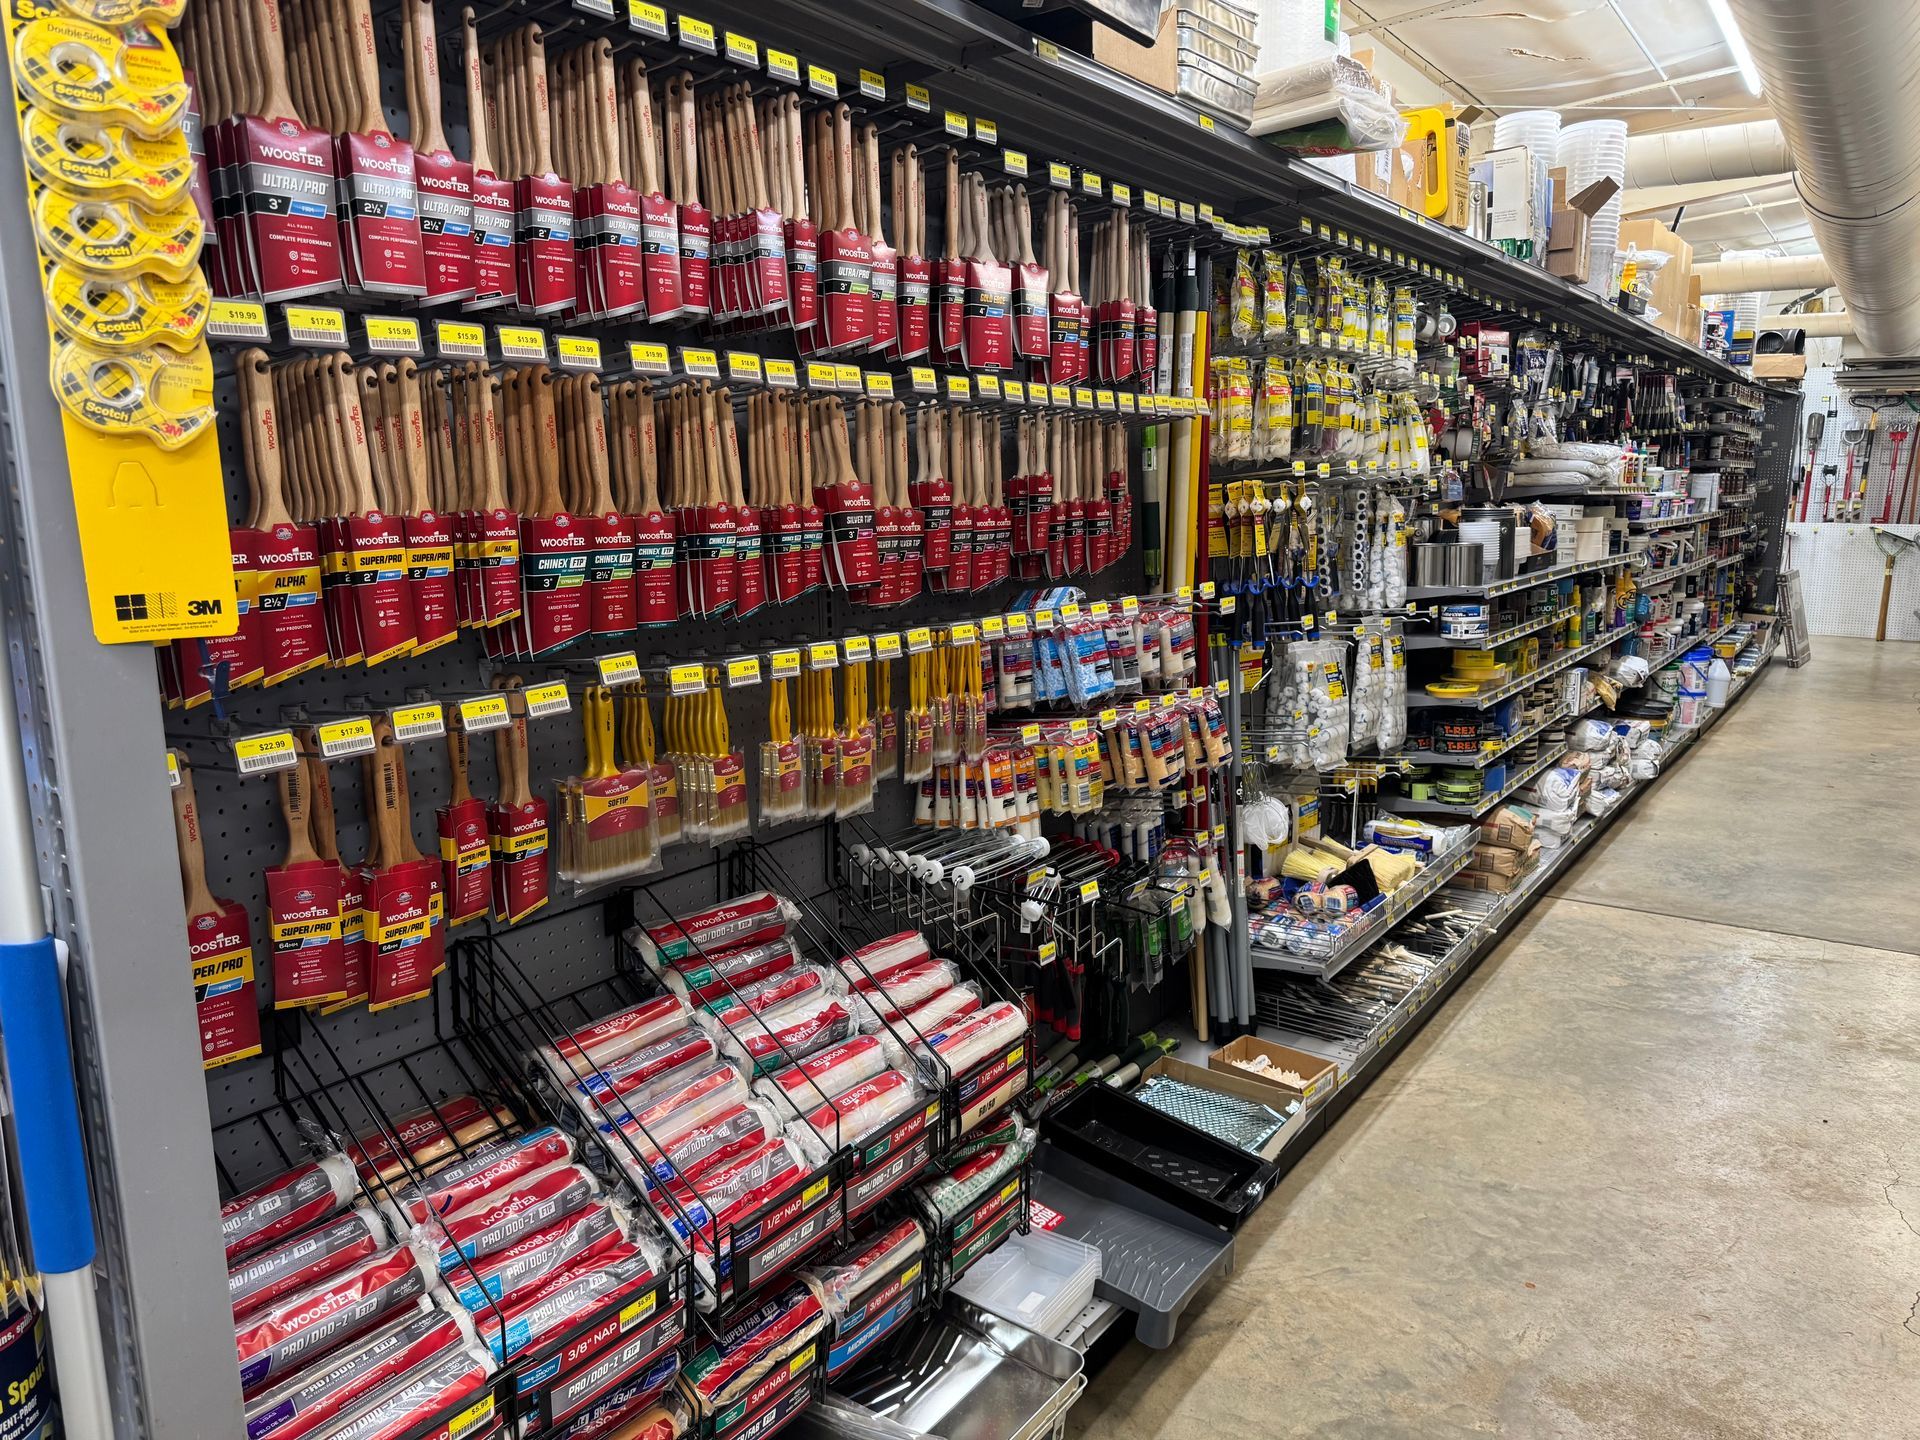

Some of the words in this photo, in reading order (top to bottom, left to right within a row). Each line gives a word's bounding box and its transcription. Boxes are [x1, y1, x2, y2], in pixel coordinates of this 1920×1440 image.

[644, 9, 661, 21] $13.99
[55, 83, 103, 103] Scotch
[259, 145, 324, 166] WOOSTER
[62, 162, 109, 178] Scotch
[358, 157, 412, 175] WOOSTER
[262, 173, 326, 195] ULTRA/PRO
[363, 181, 413, 200] ULTRA/PRO
[421, 176, 470, 193] WOOSTER
[473, 193, 510, 208] OOSTER
[535, 195, 571, 208] WOOSTER
[423, 200, 470, 217] ULTRA/PRO
[606, 202, 638, 214] WOOSTER
[537, 214, 571, 226] ULTRA/PRO
[645, 212, 675, 225] WOOSTER
[683, 223, 709, 234] WOOSTER
[163, 244, 185, 255] 3M
[795, 239, 817, 248] WOOSTER
[85, 246, 130, 257] Scotch
[838, 247, 869, 260] WOOSTER
[838, 266, 869, 279] ULTRA/PRO
[906, 272, 928, 281] WOOSTER
[229, 310, 257, 320] $19.99
[1057, 306, 1079, 315] WOOSTER
[96, 322, 141, 333] Scotch
[172, 315, 194, 328] 3M
[310, 316, 336, 328] $17.99
[388, 327, 411, 336] $15.99
[457, 332, 478, 341] $15.99
[517, 335, 538, 344] $13.99
[575, 345, 593, 353] $23.99
[646, 349, 663, 359] $19.99
[85, 401, 129, 422] Scotch
[162, 423, 184, 436] 3M
[261, 407, 276, 450] WOOSTER
[843, 495, 871, 507] WOOSTER
[709, 519, 736, 529] WOOSTER
[804, 519, 824, 527] WOOSTER
[846, 516, 862, 525] SILVER
[409, 531, 449, 544] WOOSTER
[486, 527, 517, 537] WOOSTER
[595, 531, 632, 544] WOOSTER
[639, 530, 673, 540] WOOSTER
[355, 532, 400, 547] WOOSTER
[540, 532, 585, 548] WOOSTER
[494, 544, 512, 553] ALPHA
[259, 547, 313, 565] WOOSTER
[359, 554, 402, 567] SUPER/PRO
[411, 551, 450, 563] SUPER/PRO
[594, 553, 618, 564] CHINEX
[538, 558, 569, 571] CHINEX
[274, 575, 307, 589] ALPHA
[187, 599, 222, 616] 3M
[615, 660, 632, 669] $14.99
[684, 670, 699, 679] $10.99
[542, 690, 561, 699] $14.99
[479, 704, 500, 713] $17.99
[412, 711, 435, 721] $17.99
[341, 726, 364, 737] $17.99
[1444, 726, 1476, 735] T-REX
[259, 740, 285, 751] $22.99
[1447, 741, 1477, 750] T-REX
[605, 784, 629, 796] WOOSTER
[607, 795, 629, 807] SOFTIP
[184, 802, 198, 842] WOOSTER
[513, 818, 546, 833] WOOSTER
[460, 838, 486, 851] WOOSTER
[514, 833, 546, 848] SUPER/PRO
[460, 851, 487, 864] SUPER/PRO
[282, 906, 329, 920] WOOSTER
[386, 906, 423, 924] WOOSTER
[692, 910, 739, 929] WOOSTER
[281, 920, 335, 937] SUPER/PRO
[385, 921, 427, 939] SUPER/PRO
[201, 1011, 234, 1024] ALL-PURPOSE
[811, 1048, 847, 1067] WOOSTER
[908, 1117, 922, 1131] NAP
[482, 1195, 539, 1226] WOOSTER
[767, 1209, 783, 1229] 1/2"
[785, 1199, 802, 1216] NAP
[281, 1288, 361, 1334] WOOSTER
[721, 1313, 760, 1346] SUPER/FAB
[568, 1337, 592, 1360] 3/8"
[594, 1323, 617, 1344] NAP
[8, 1360, 45, 1407] Spout
[751, 1385, 769, 1404] 3/4"
[769, 1371, 787, 1390] NAP
[471, 1399, 488, 1417] $5.99
[25, 1410, 40, 1427] Cans
